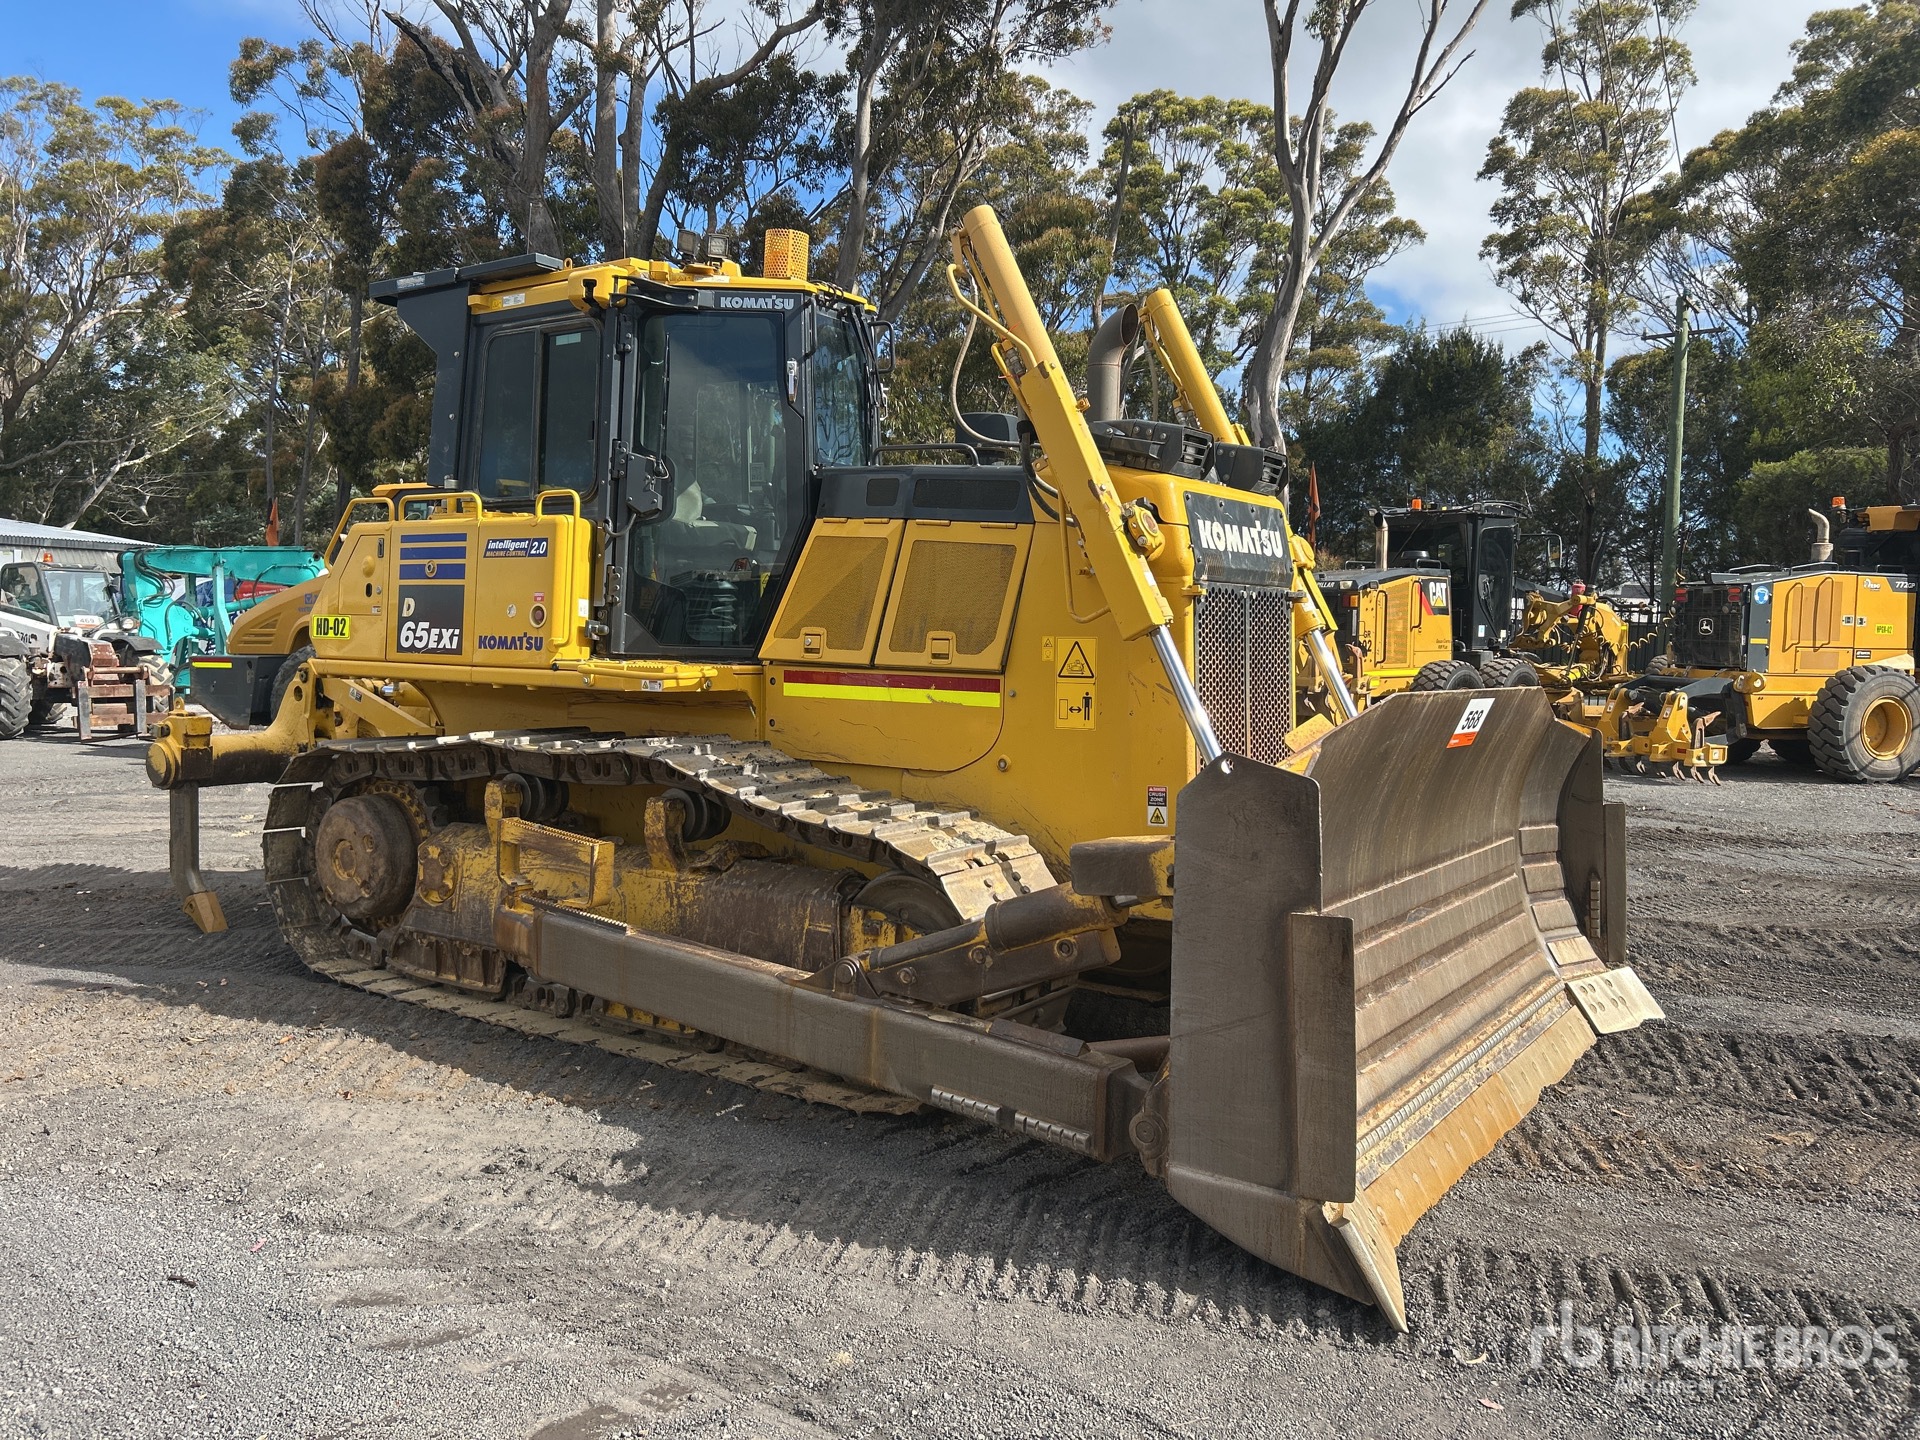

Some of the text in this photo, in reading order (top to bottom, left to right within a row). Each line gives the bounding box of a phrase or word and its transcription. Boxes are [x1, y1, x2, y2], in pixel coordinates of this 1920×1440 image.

[720, 294, 795, 310] KOMATSU
[488, 540, 547, 555] intelligent 2.0
[1197, 519, 1284, 559] KOMATSU
[1428, 581, 1447, 607] CAT
[401, 597, 416, 618] D
[316, 617, 347, 637] HD-02
[400, 620, 461, 649] 65EXi
[478, 632, 544, 652] KOMATSU
[1461, 709, 1484, 731] 568
